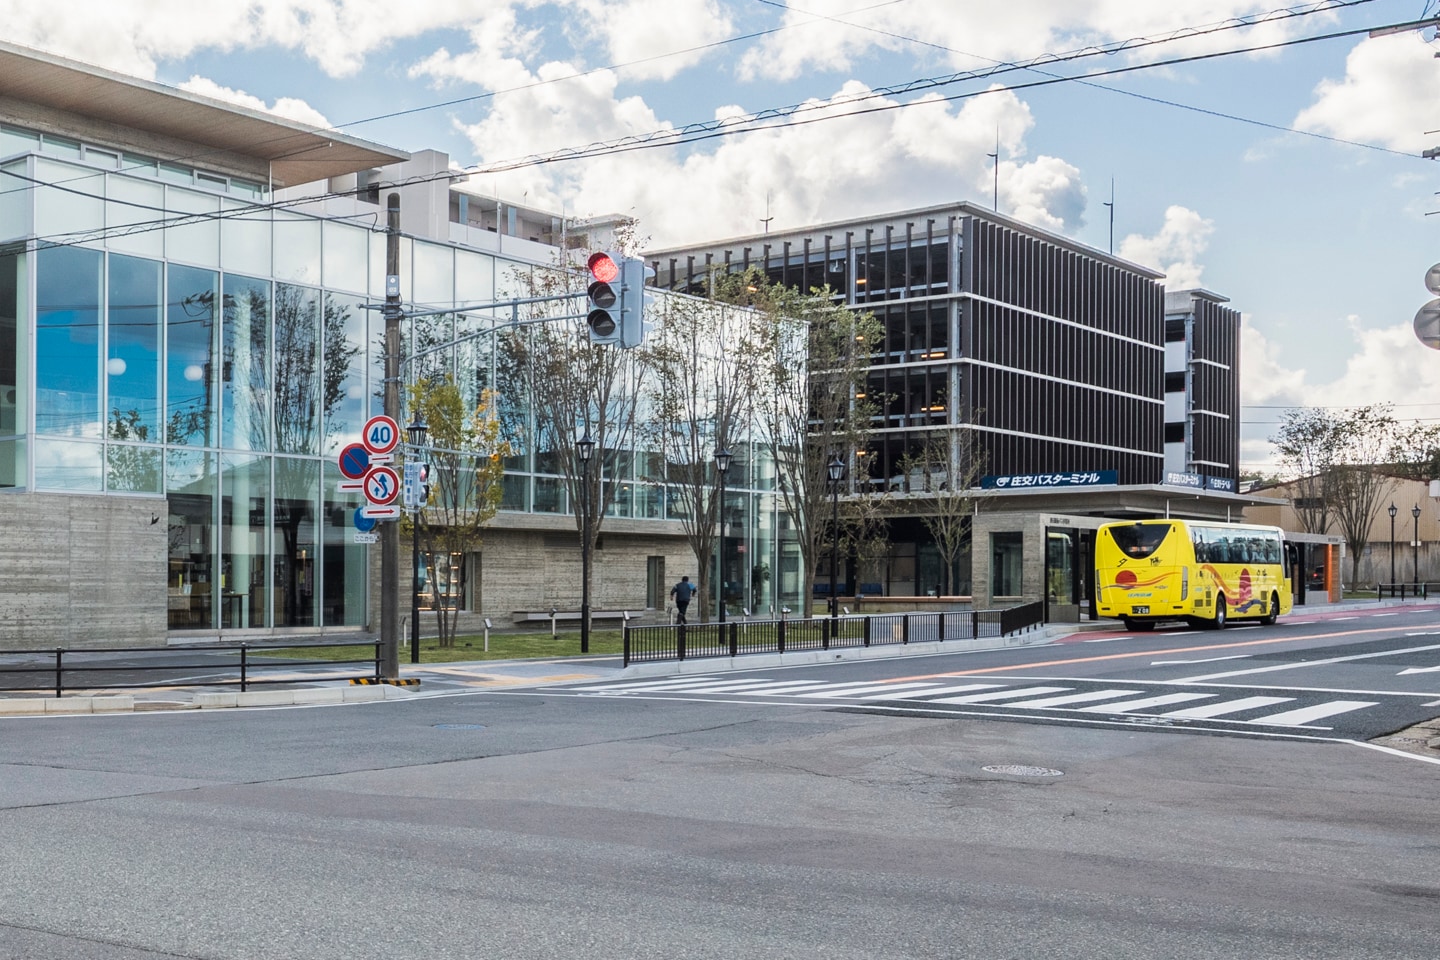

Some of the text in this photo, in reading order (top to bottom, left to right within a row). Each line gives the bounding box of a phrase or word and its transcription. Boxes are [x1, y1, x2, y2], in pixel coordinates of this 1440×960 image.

[371, 427, 390, 443] 40
[1011, 473, 1100, 486] 庄交バスターミナル
